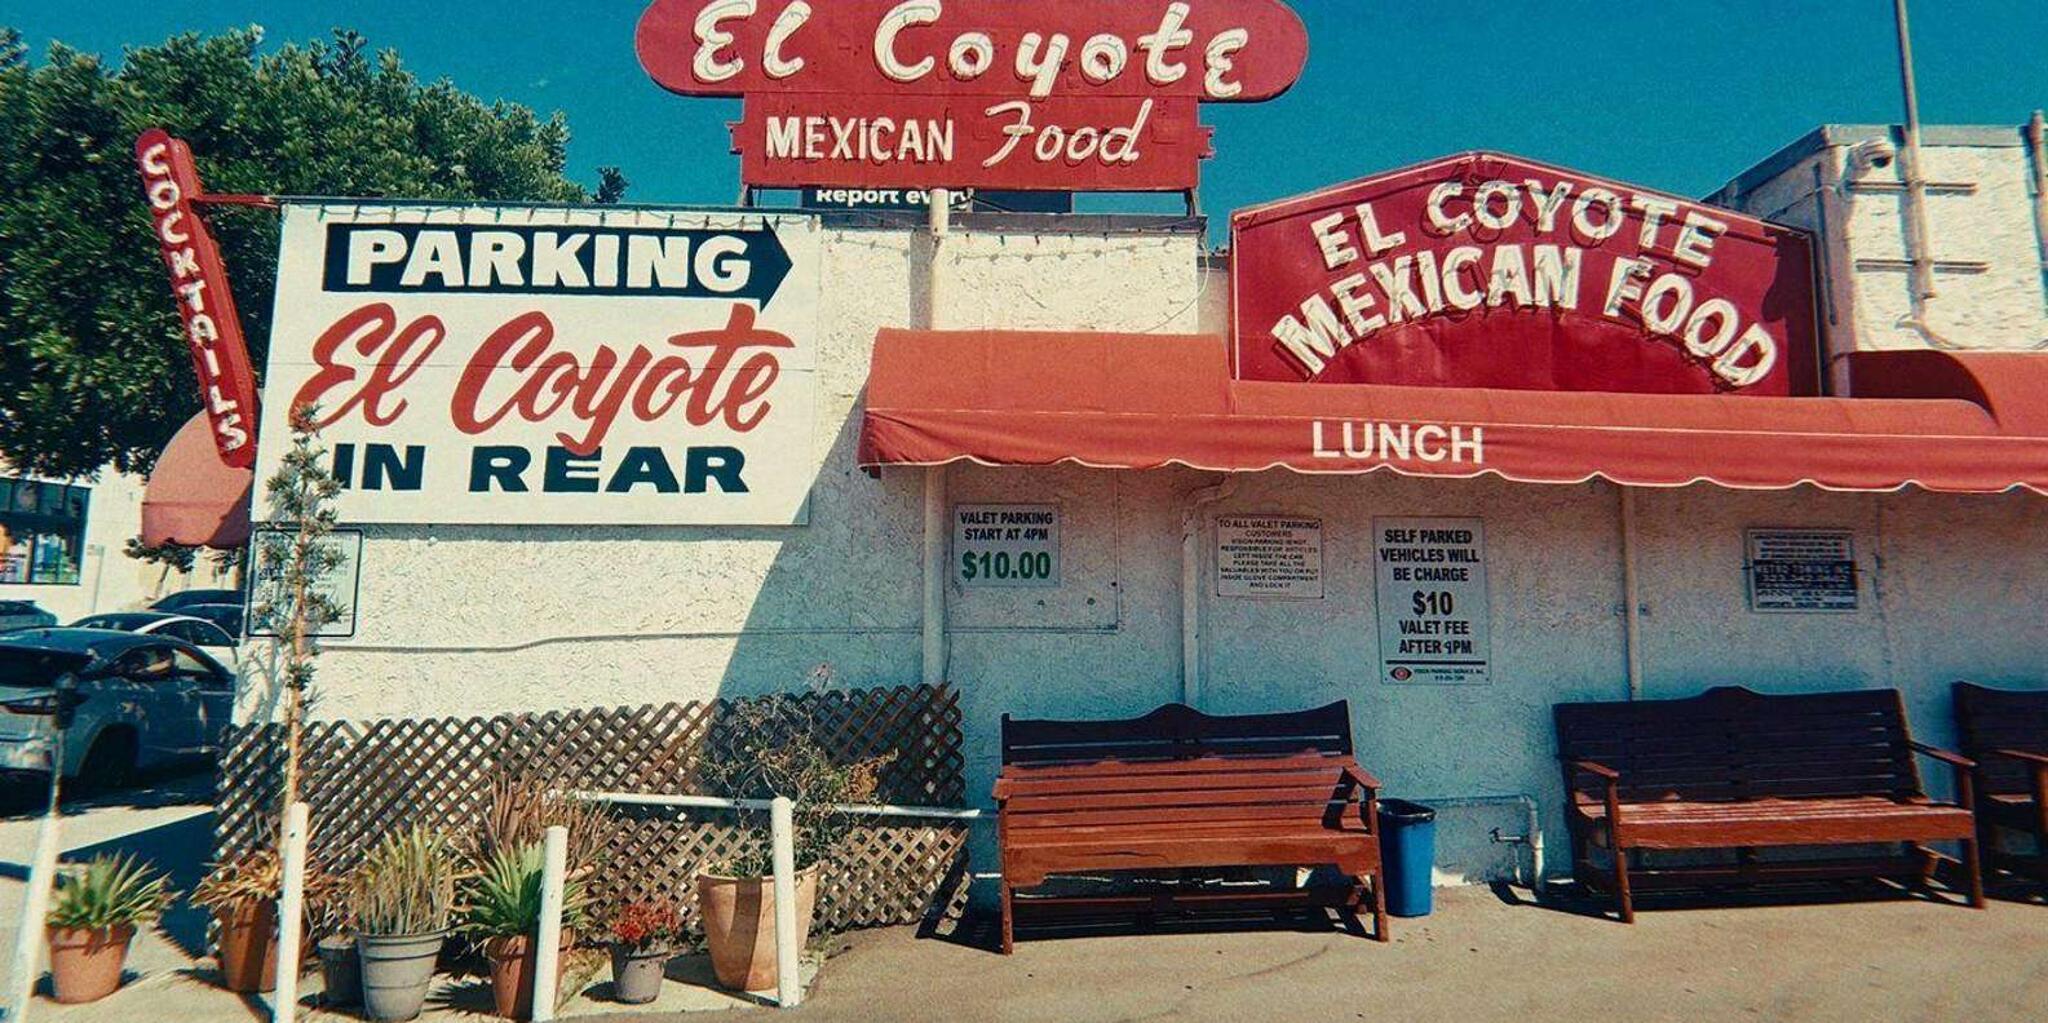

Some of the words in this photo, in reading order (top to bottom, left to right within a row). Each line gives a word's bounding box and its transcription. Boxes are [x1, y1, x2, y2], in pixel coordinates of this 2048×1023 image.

[693, 0, 791, 83] El
[874, 0, 1248, 98] Coyote
[765, 115, 954, 163] MEXICAN
[983, 99, 1154, 168] Food
[816, 189, 900, 208] Report
[905, 189, 973, 210] evry
[1310, 203, 1406, 272] EL
[1426, 178, 1728, 268] COYOTE
[346, 229, 752, 292] PARKING
[143, 143, 248, 452] COCKTAILS
[1271, 243, 1582, 375] MEXICAN
[1602, 255, 1779, 388] FOOD
[288, 302, 446, 432] El
[450, 303, 795, 456] Coyote
[1311, 420, 1484, 465] LUNCH
[332, 443, 426, 491] IN
[468, 445, 750, 494] REAR
[960, 511, 998, 525] VALET
[1000, 511, 1053, 525] PARKING
[1220, 519, 1231, 528] TO
[1233, 519, 1249, 528] ALL
[1251, 520, 1278, 529] VALET
[1280, 520, 1320, 530] PARKING
[964, 528, 1002, 540] START
[1005, 528, 1021, 540] AT
[1023, 528, 1049, 540] 4PM
[1385, 529, 1417, 543] SELF
[1420, 530, 1472, 543] PARKED
[962, 550, 1051, 582] $10.00
[1380, 548, 1445, 563] VEHICLES
[1446, 549, 1480, 563] WILL
[1393, 567, 1411, 581] BE
[1414, 568, 1469, 582] CHARGE
[1413, 590, 1453, 617] $10
[1399, 620, 1441, 635] VALET
[1444, 620, 1470, 635] FEE
[1398, 639, 1442, 654] AFTER
